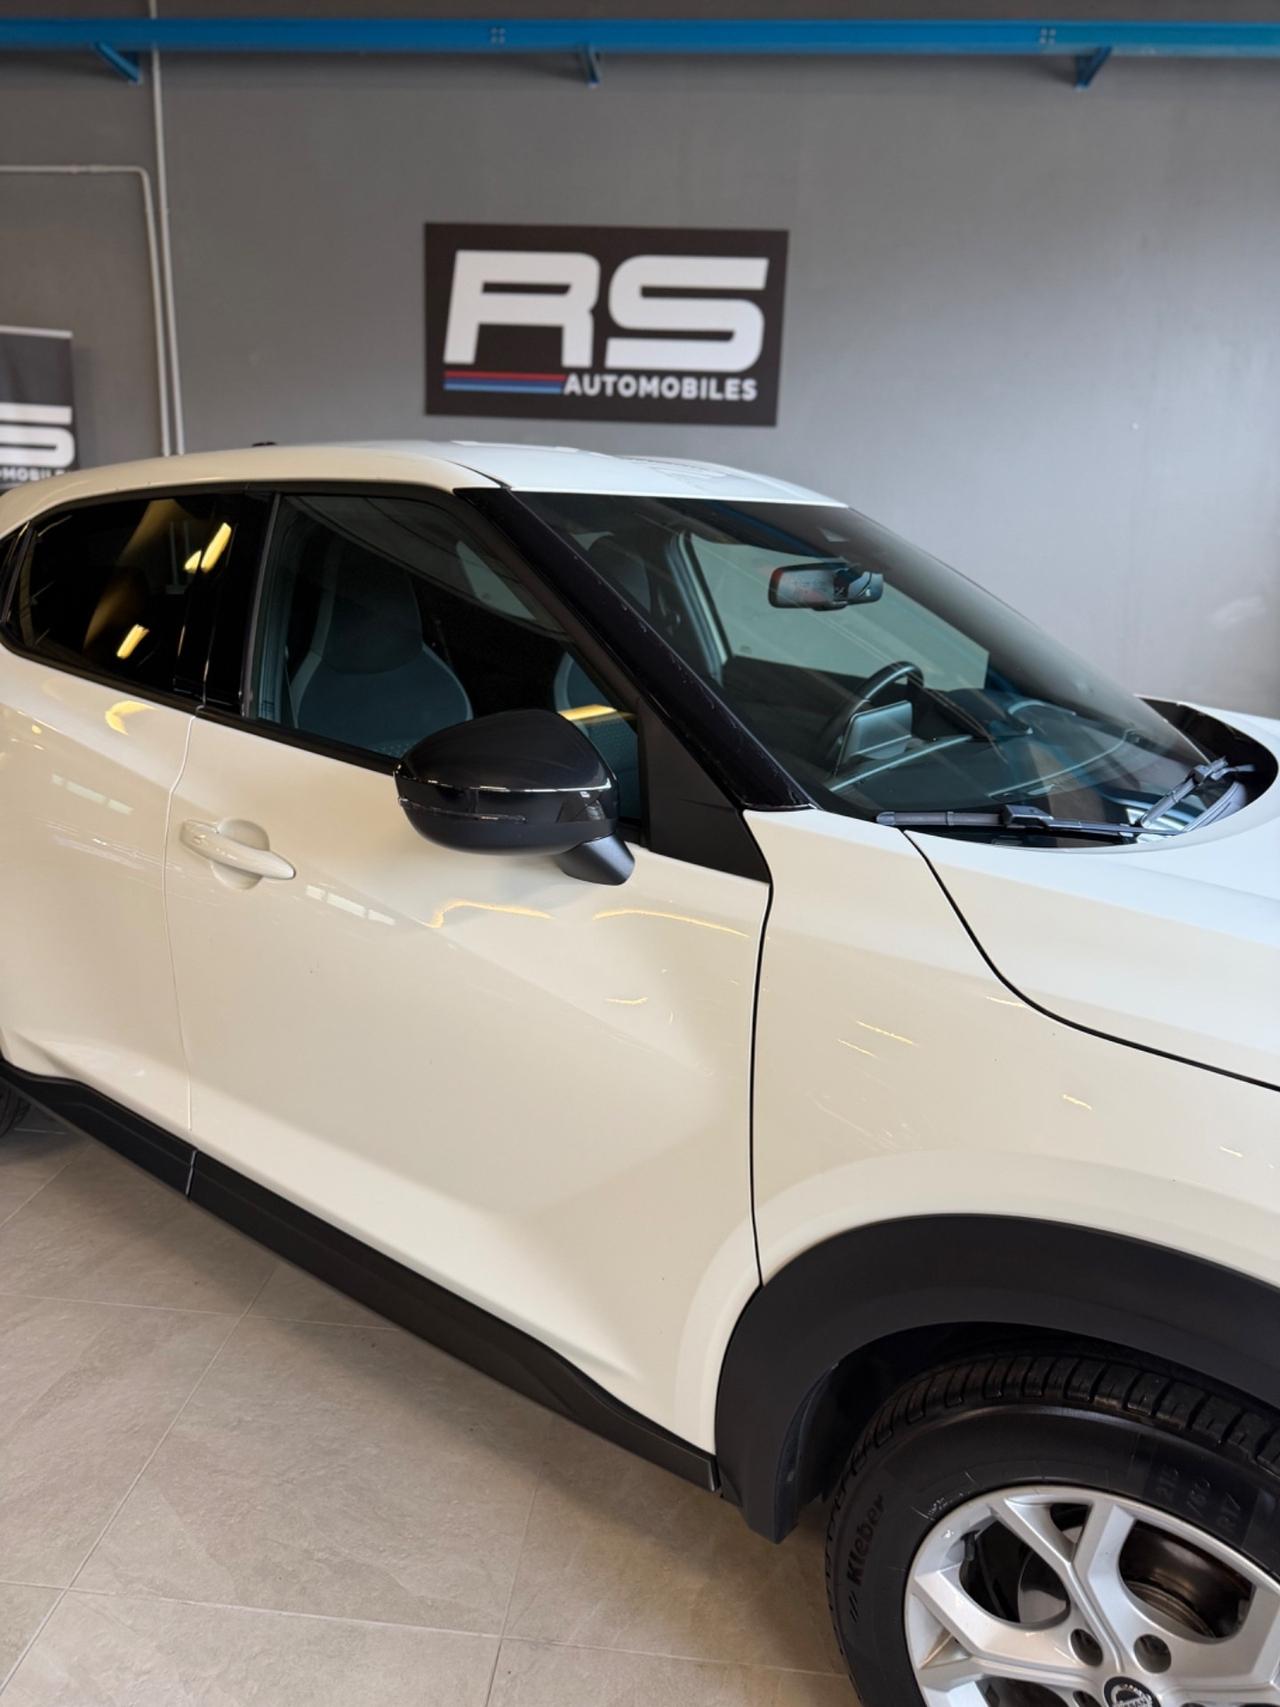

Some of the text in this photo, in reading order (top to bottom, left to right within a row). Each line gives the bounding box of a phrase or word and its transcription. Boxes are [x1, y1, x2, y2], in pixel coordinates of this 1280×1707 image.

[444, 250, 769, 372] RS
[563, 374, 758, 401] AUTOMOBILES
[847, 1494, 884, 1586] Kleber
